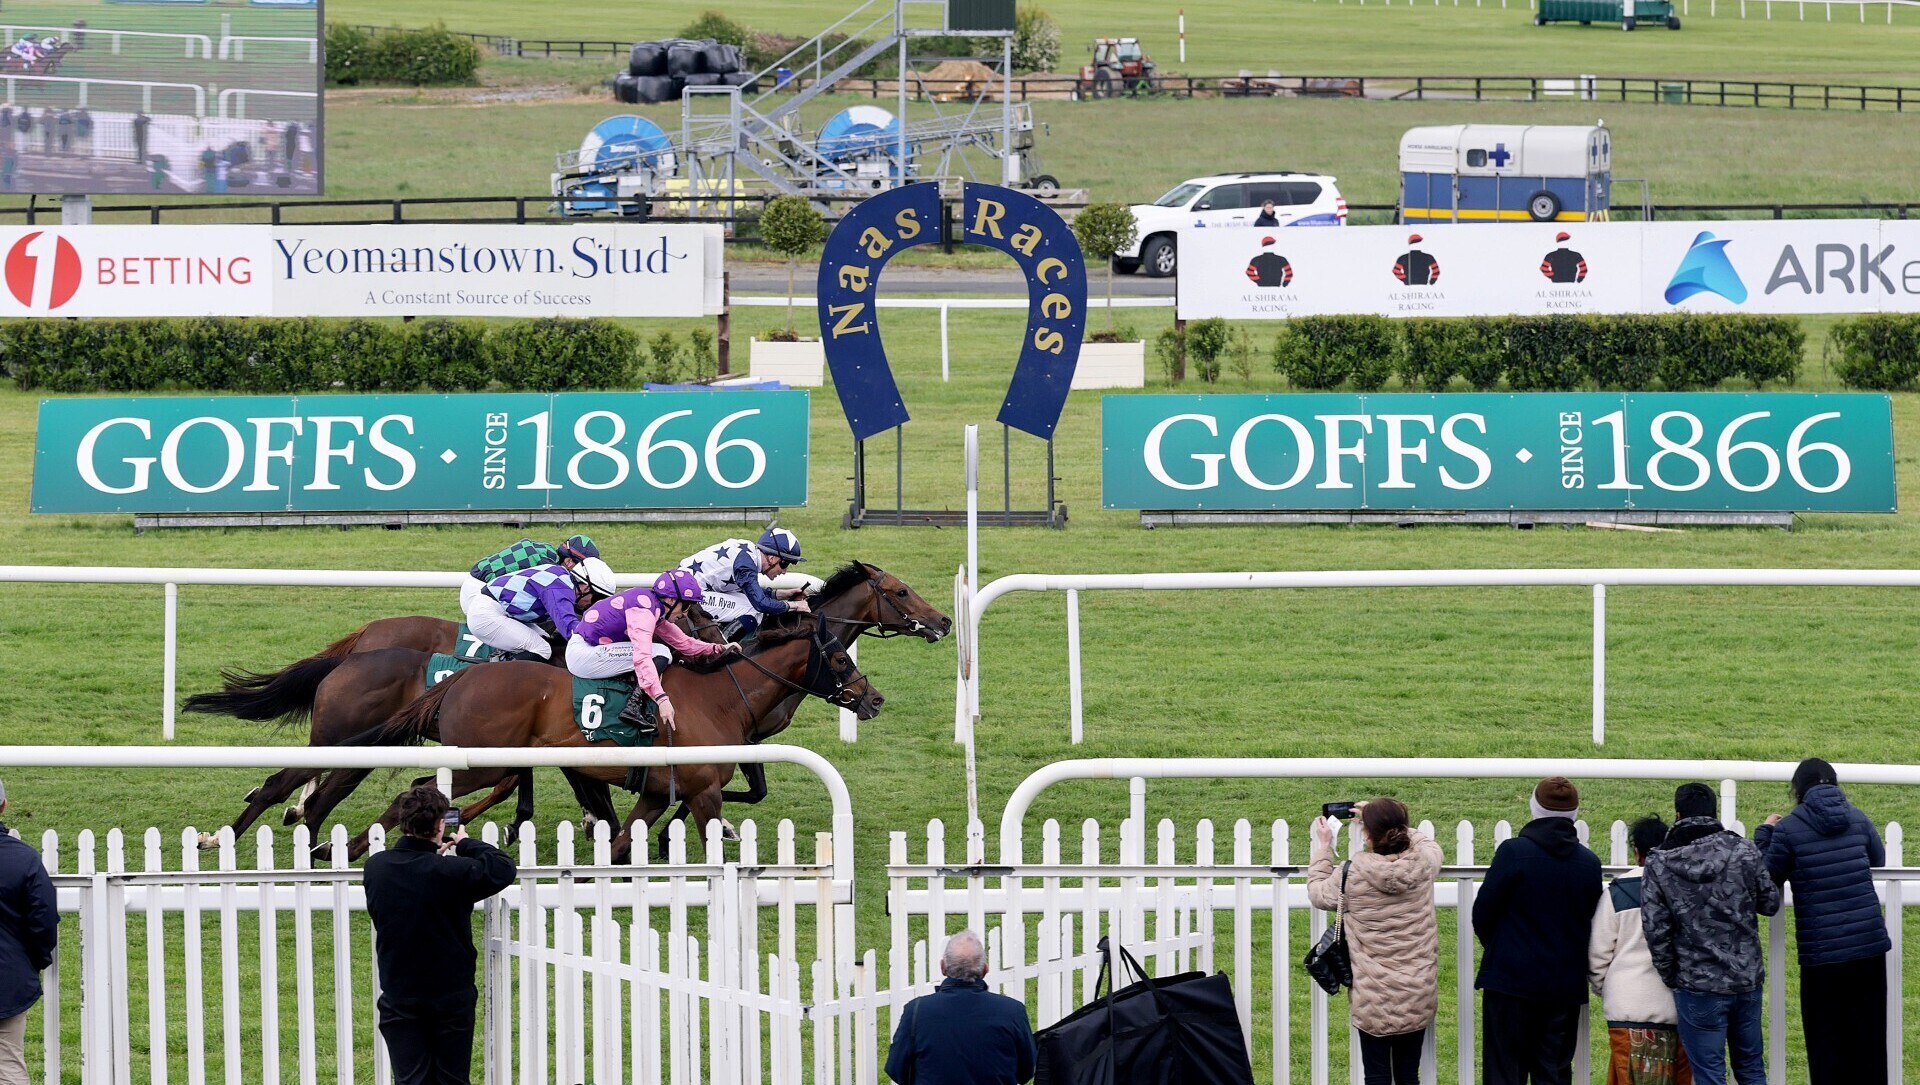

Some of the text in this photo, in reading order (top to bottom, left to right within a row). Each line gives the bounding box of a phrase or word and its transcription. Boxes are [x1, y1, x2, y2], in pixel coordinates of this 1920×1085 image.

[572, 236, 688, 279] Stud
[97, 257, 252, 285] BETTING
[828, 198, 1072, 355] Naas Races
[364, 289, 591, 305] A Constant Source of Success
[1241, 294, 1252, 302] AL
[1388, 293, 1400, 301] AL
[1536, 291, 1547, 299] AL
[1252, 305, 1288, 313] RACING
[1398, 303, 1434, 311] RACING
[1546, 301, 1582, 309] RACING
[76, 409, 767, 494] GOFFS SINCE 1866
[1143, 410, 1851, 493] GOFFS SINCE 1866
[719, 597, 736, 609] Ryan
[462, 633, 484, 657] 7
[581, 693, 605, 729] 6
